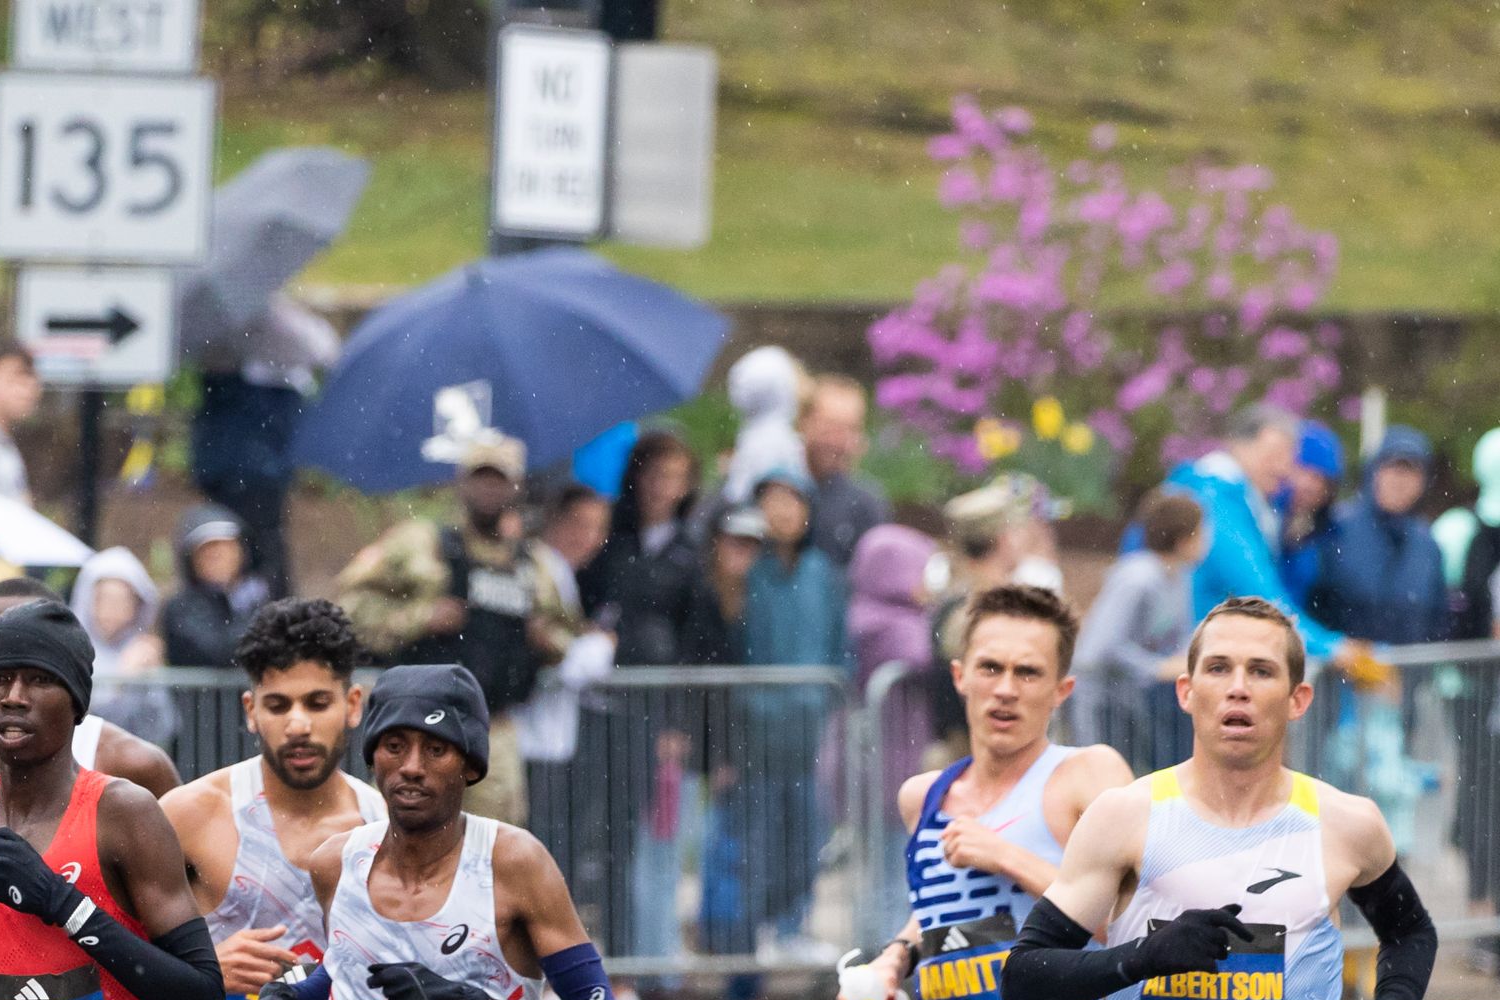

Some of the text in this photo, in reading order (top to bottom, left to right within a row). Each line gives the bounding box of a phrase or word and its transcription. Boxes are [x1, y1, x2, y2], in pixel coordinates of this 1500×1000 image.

[41, 1, 167, 46] WEST
[534, 64, 578, 104] NO
[17, 116, 184, 215] 135
